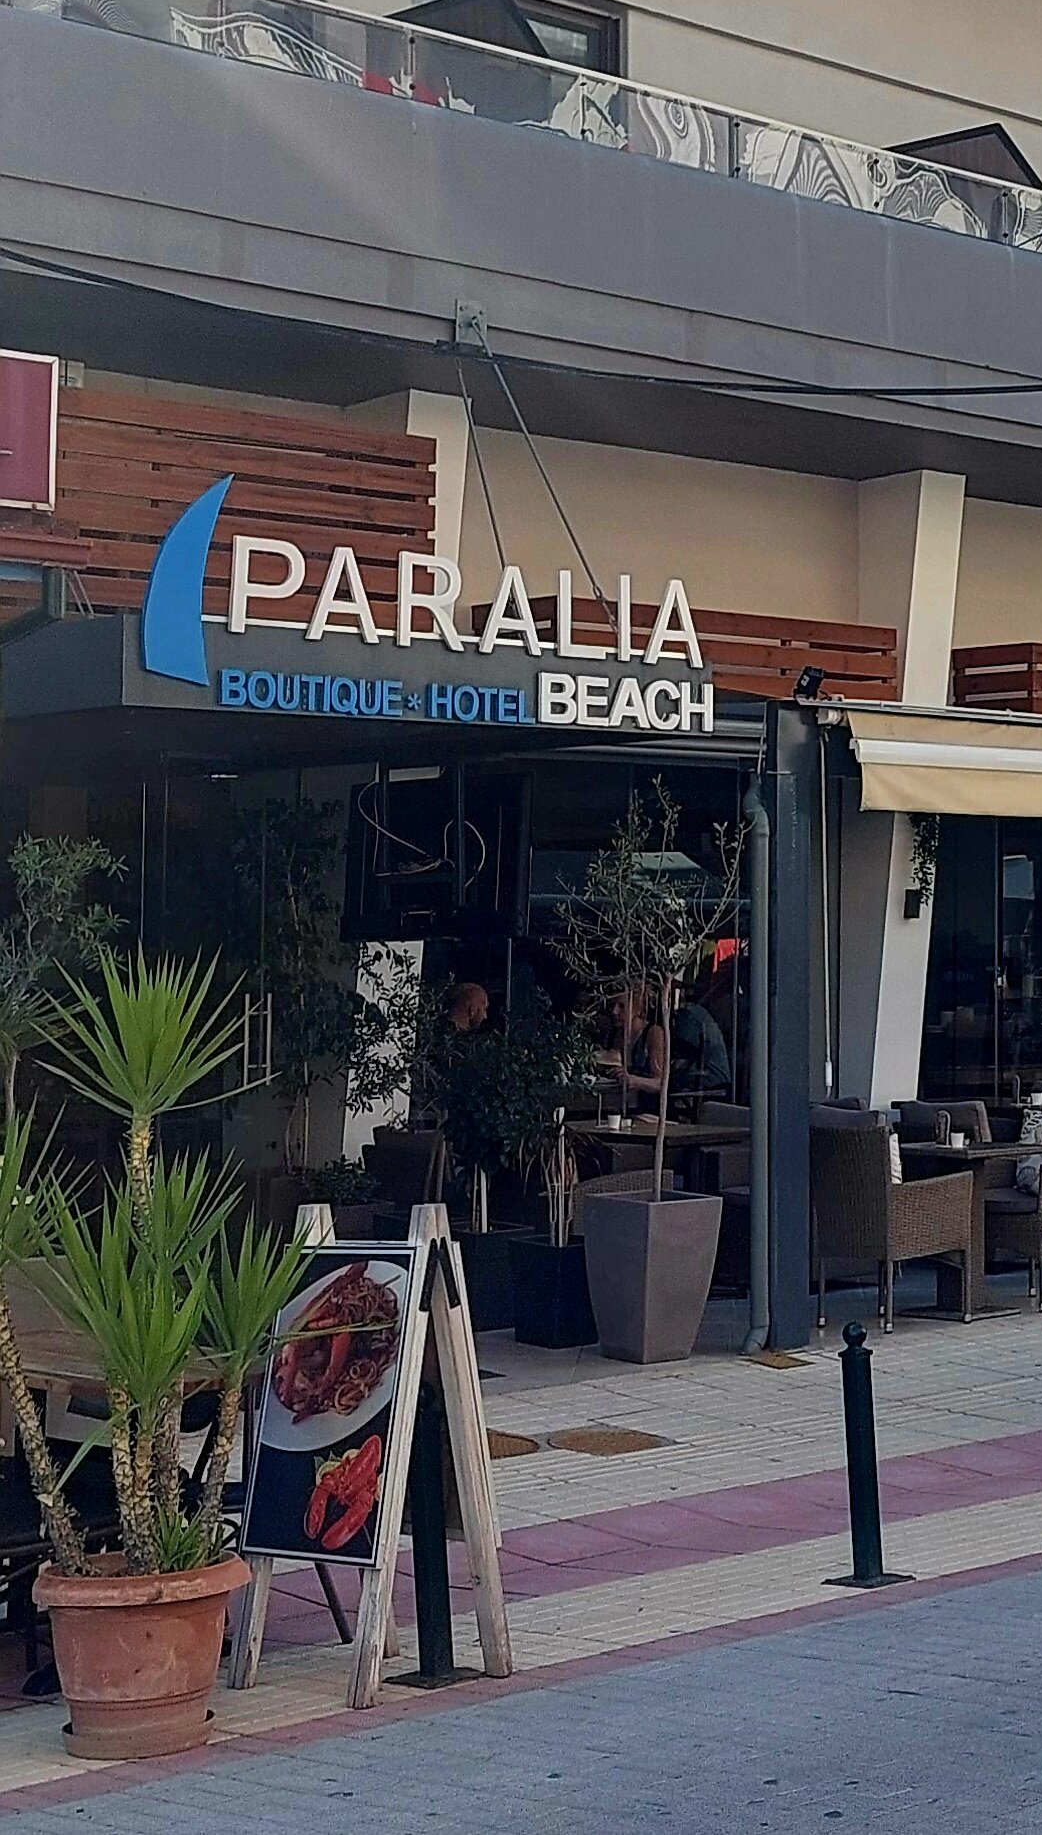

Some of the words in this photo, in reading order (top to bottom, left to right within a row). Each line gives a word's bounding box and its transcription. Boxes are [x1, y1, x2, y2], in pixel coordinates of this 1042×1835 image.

[227, 534, 704, 669] PARALIA
[219, 669, 403, 717] BOUTIQUE
[427, 683, 537, 726] HOTEL
[537, 672, 714, 734] BEACH
